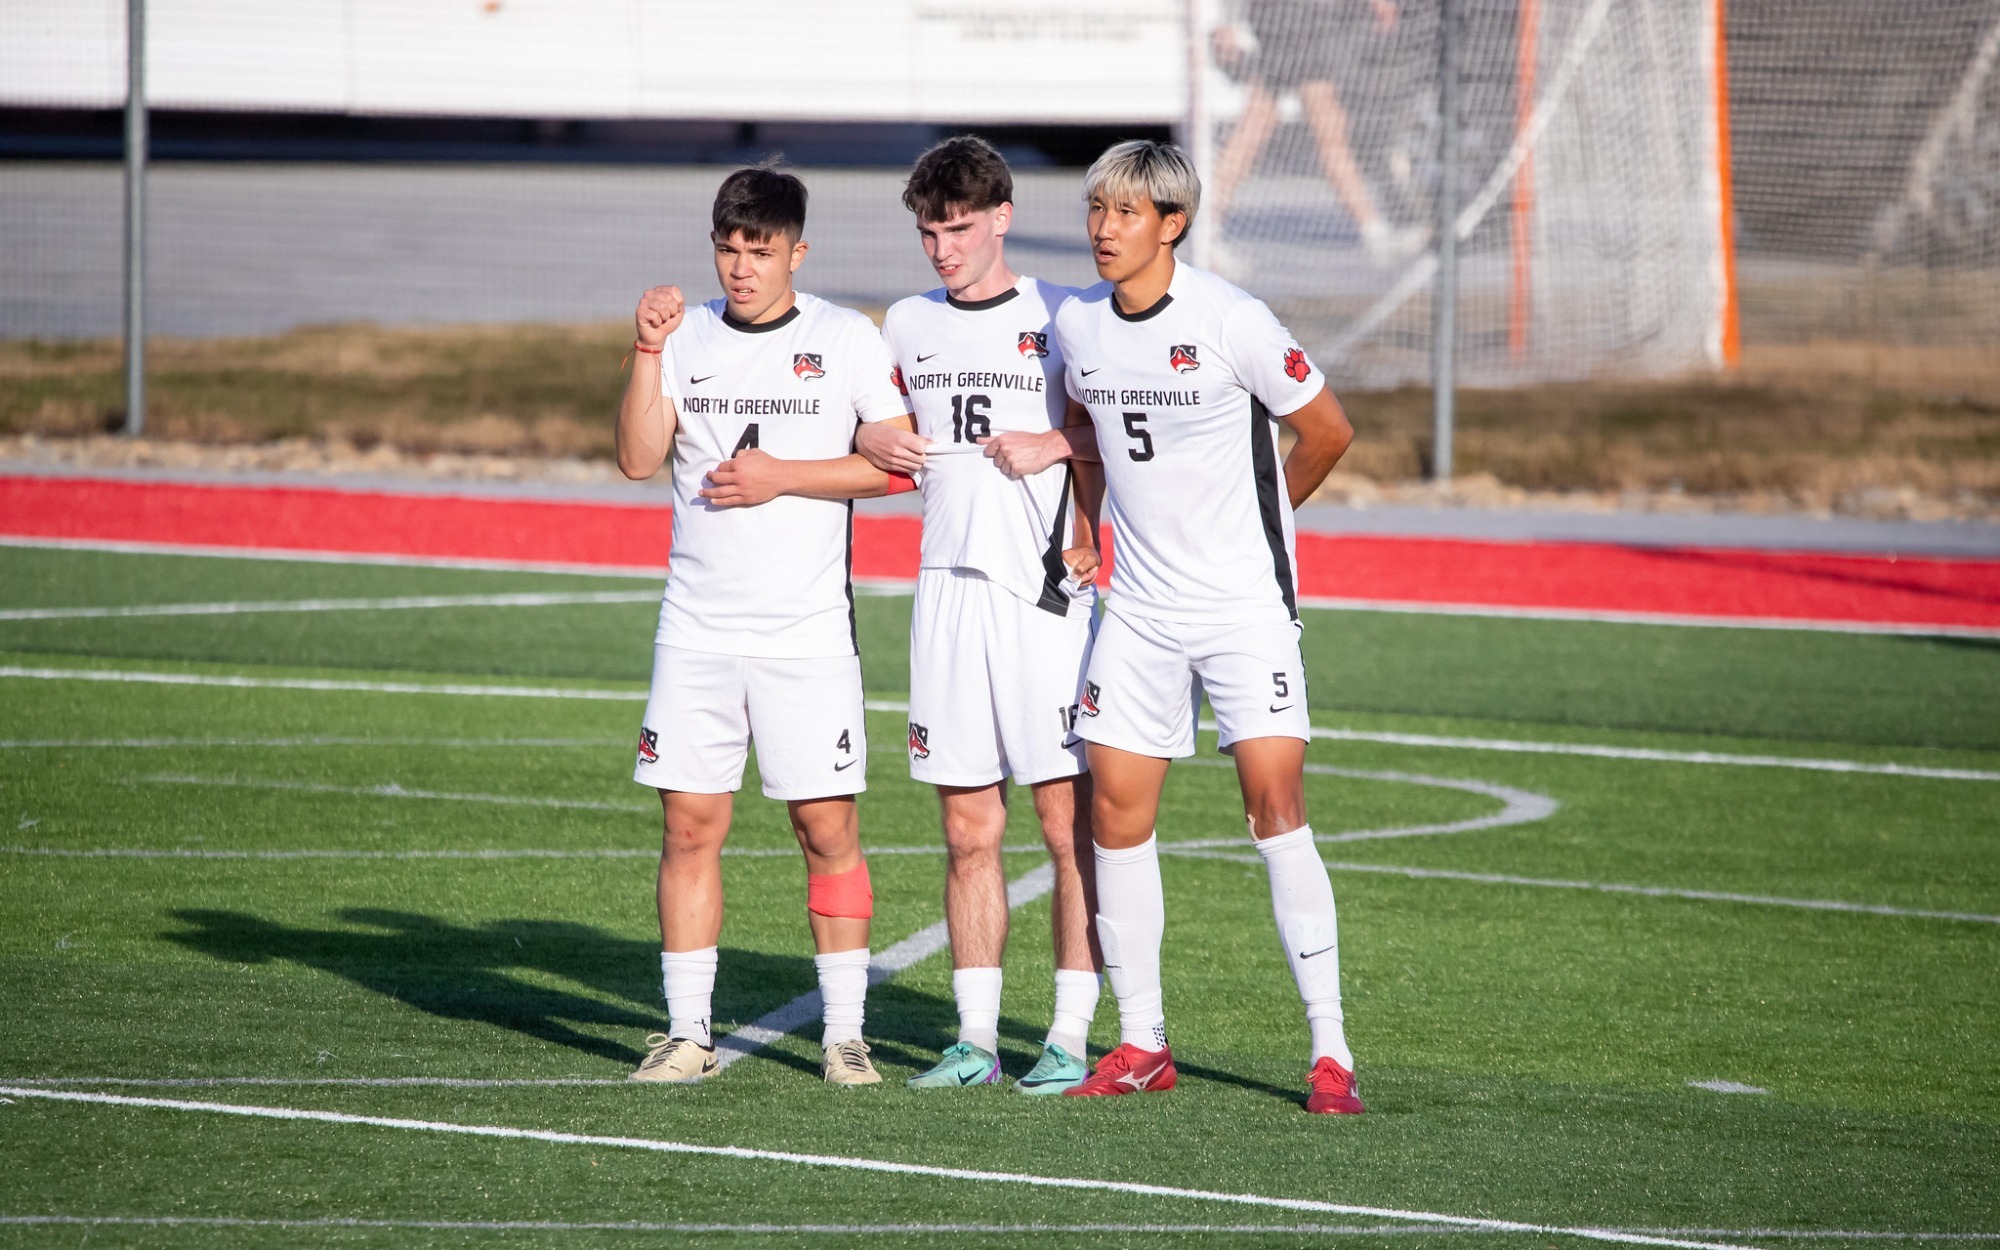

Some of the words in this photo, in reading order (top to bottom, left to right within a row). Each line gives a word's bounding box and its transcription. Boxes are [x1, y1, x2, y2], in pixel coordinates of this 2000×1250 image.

[909, 372, 952, 392] NORTH
[957, 372, 1044, 393] GREENVILLE
[683, 397, 729, 414] NORTH
[734, 398, 820, 415] GREENVILLE
[1078, 388, 1116, 406] NORTH
[1121, 389, 1201, 406] GREENVILLE
[951, 394, 992, 444] 16
[1122, 412, 1155, 462] 5
[1272, 672, 1289, 698] 5
[836, 728, 851, 754] 4
